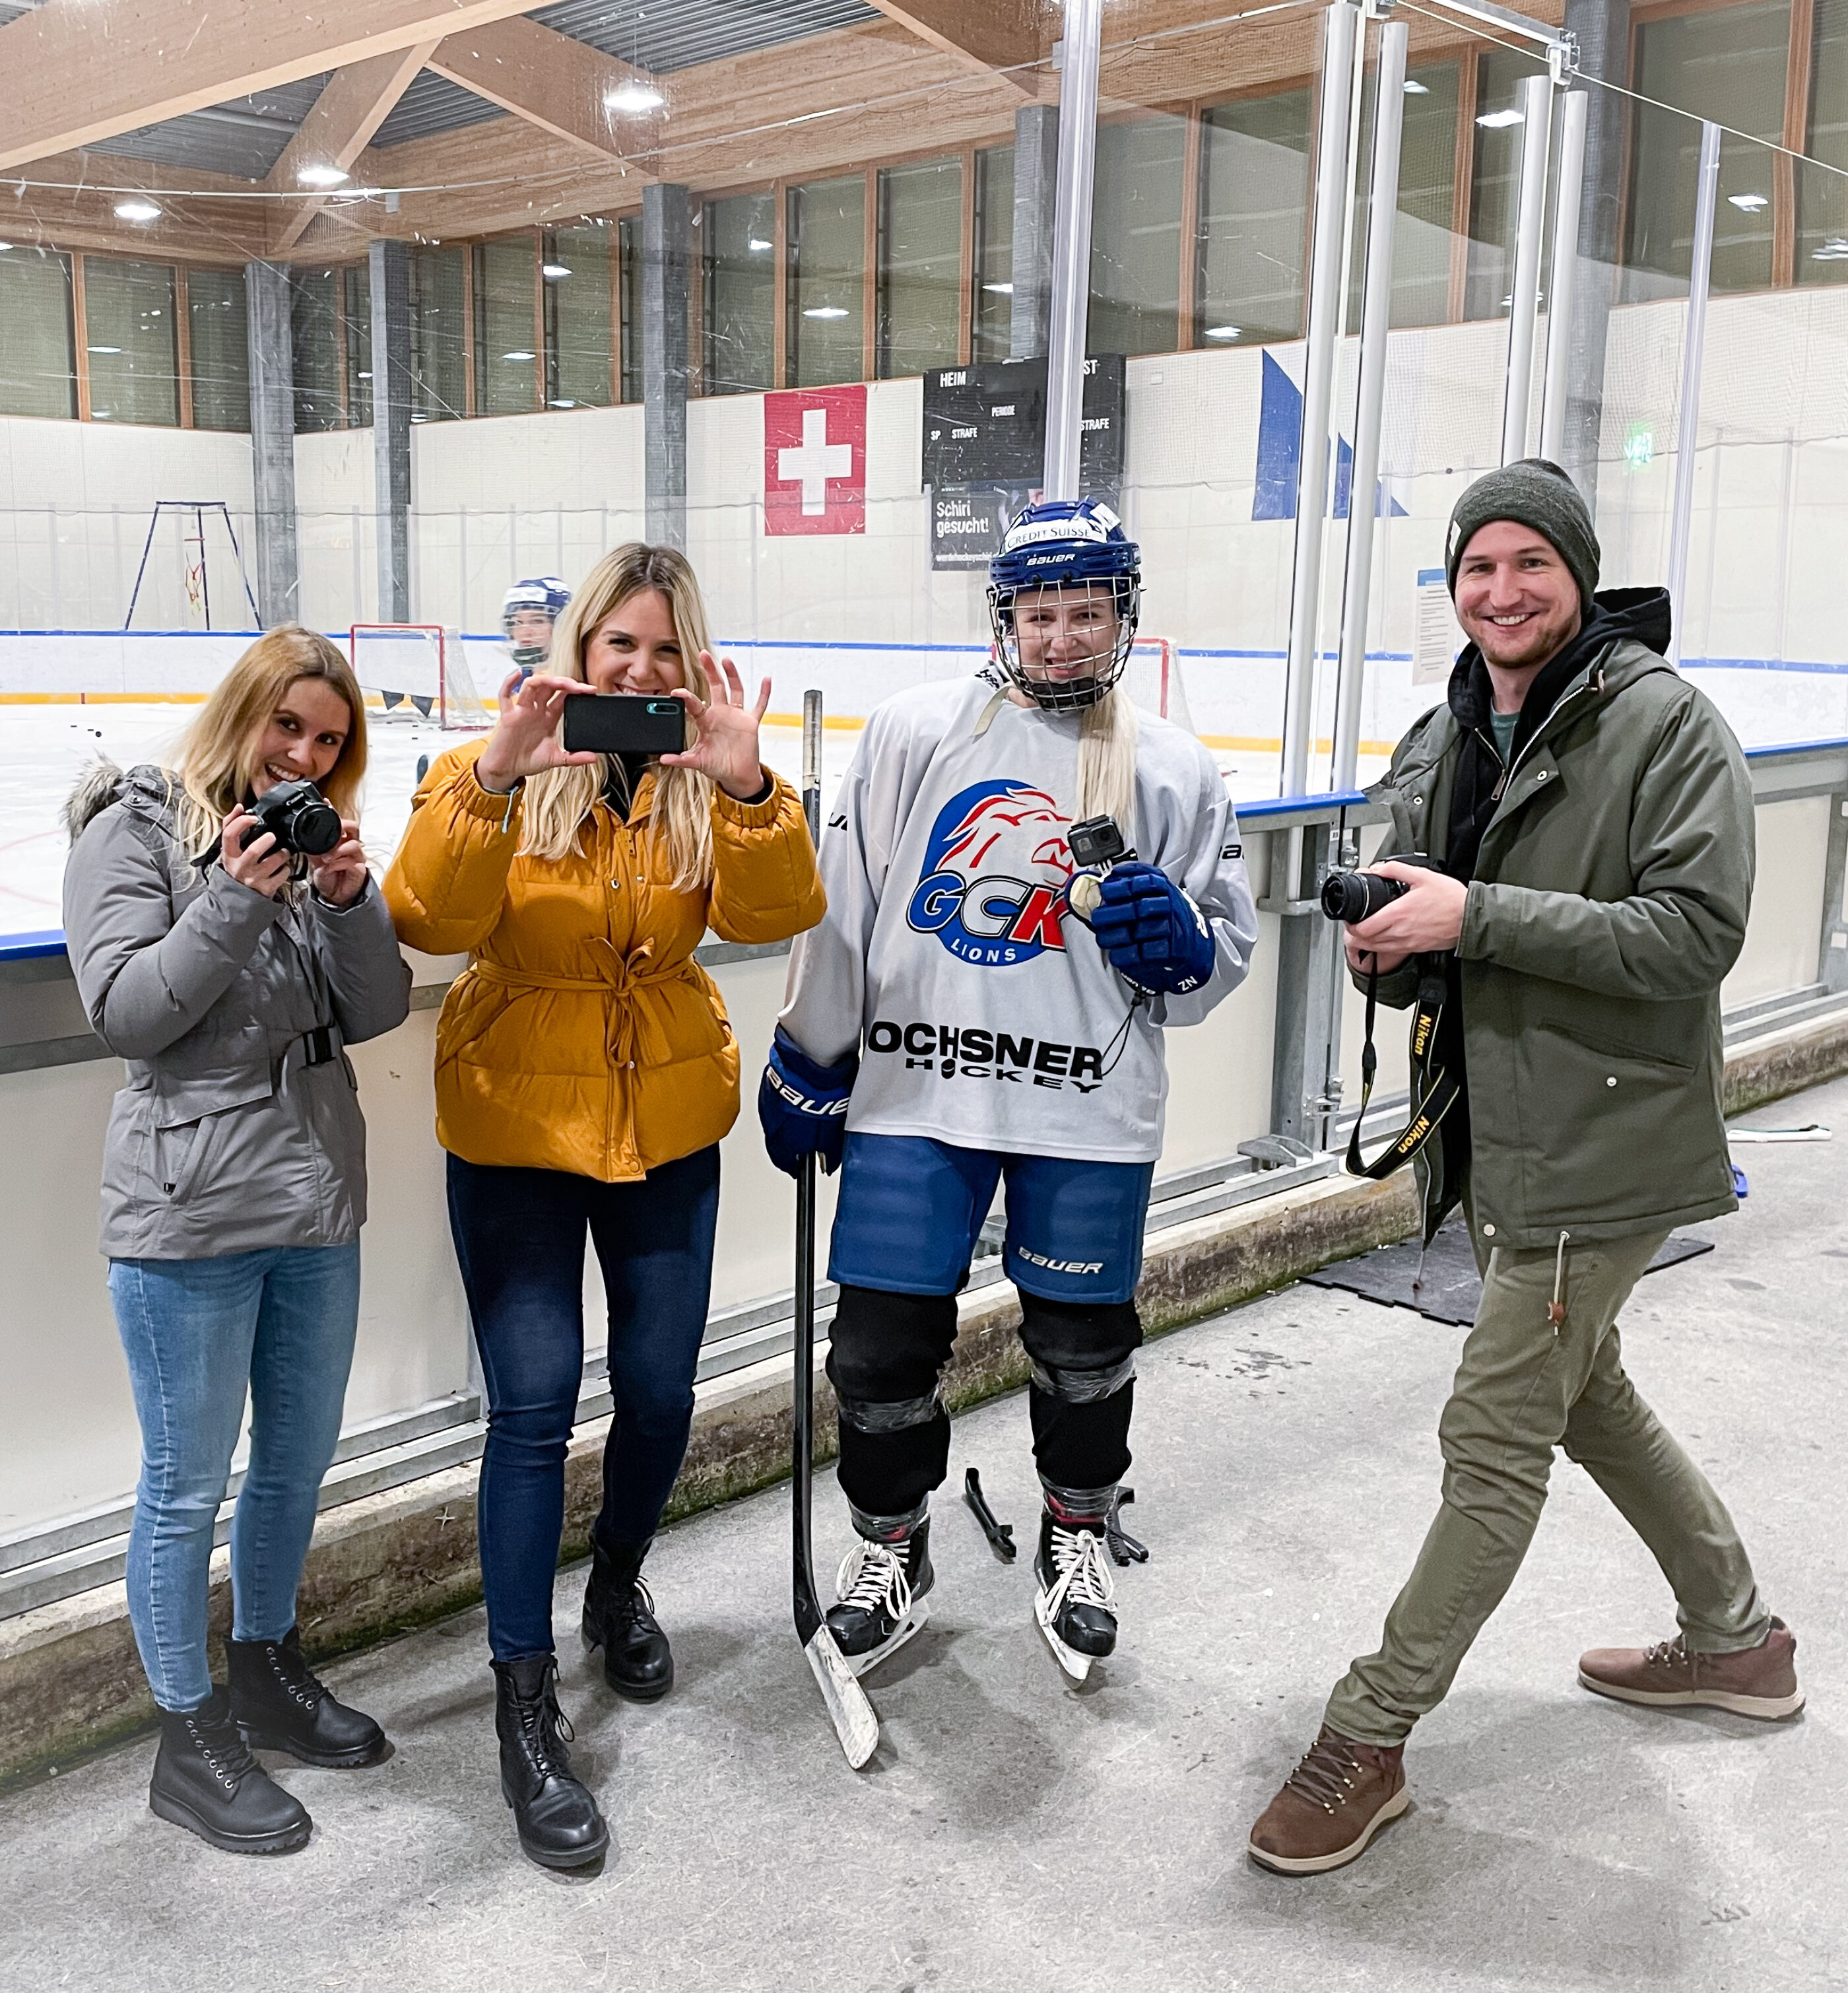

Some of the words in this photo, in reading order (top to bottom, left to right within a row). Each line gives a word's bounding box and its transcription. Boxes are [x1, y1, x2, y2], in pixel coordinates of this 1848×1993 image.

[940, 371, 966, 388] HEIM
[991, 405, 1015, 417] PERIODE
[931, 430, 941, 441] SP
[952, 427, 977, 439] STRAFE
[1080, 418, 1109, 430] STRAFE
[937, 500, 971, 518] Schiri
[937, 517, 989, 538] gesucht!
[1008, 529, 1047, 549] CREDIT
[1051, 527, 1092, 537] SUISSE
[907, 870, 1065, 952] GCK
[950, 938, 1016, 963] LIONS
[1415, 1014, 1432, 1056] Nikon
[868, 1021, 1103, 1081] OCHSNER
[1398, 1115, 1430, 1153] Nikon
